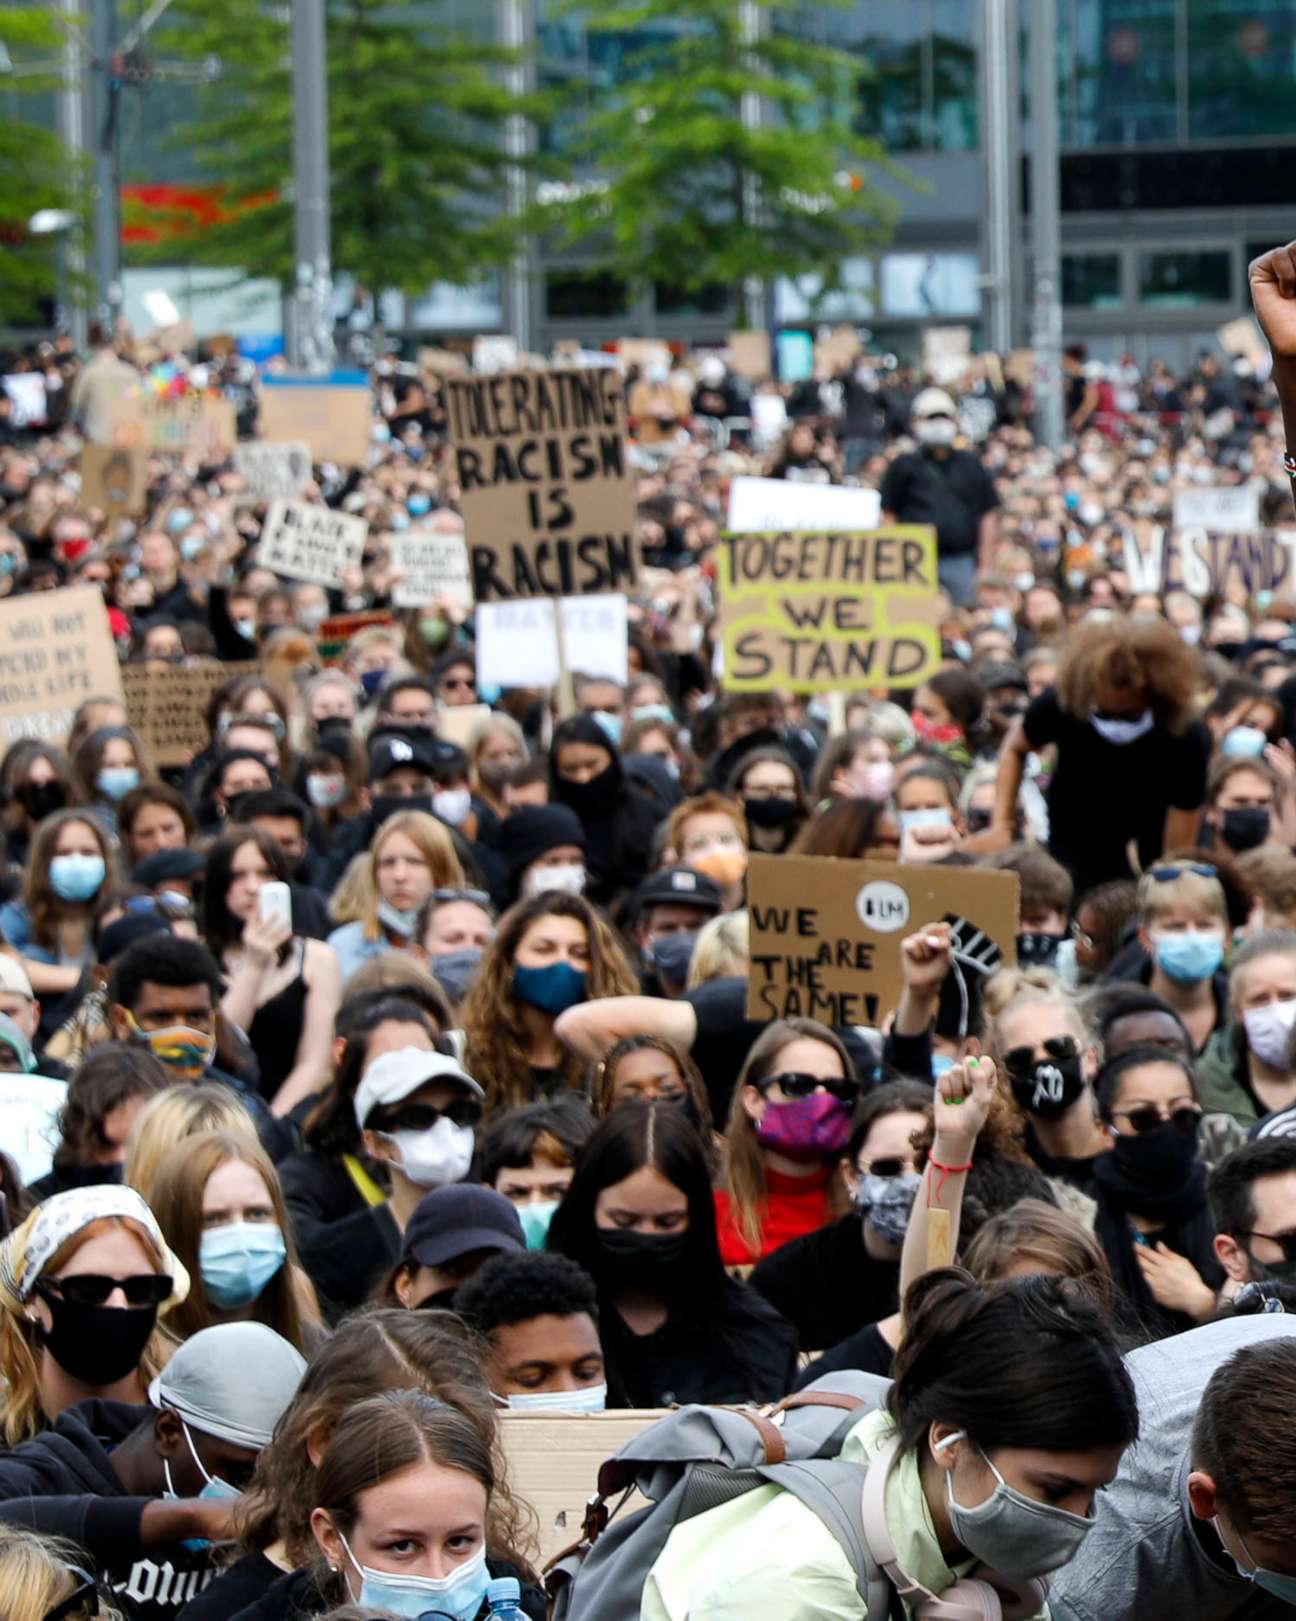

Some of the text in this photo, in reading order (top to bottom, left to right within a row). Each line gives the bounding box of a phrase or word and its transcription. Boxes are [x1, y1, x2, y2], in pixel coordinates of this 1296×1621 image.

[449, 368, 622, 439] TOLERATING
[457, 434, 624, 489] RACISM
[527, 488, 574, 530] IS
[472, 533, 638, 602] RACISM
[723, 531, 931, 588] TOGETHER
[779, 596, 870, 631] WE
[731, 632, 928, 680] STAND
[751, 904, 818, 937] WE
[752, 955, 825, 990] THE
[816, 938, 876, 971] ARE
